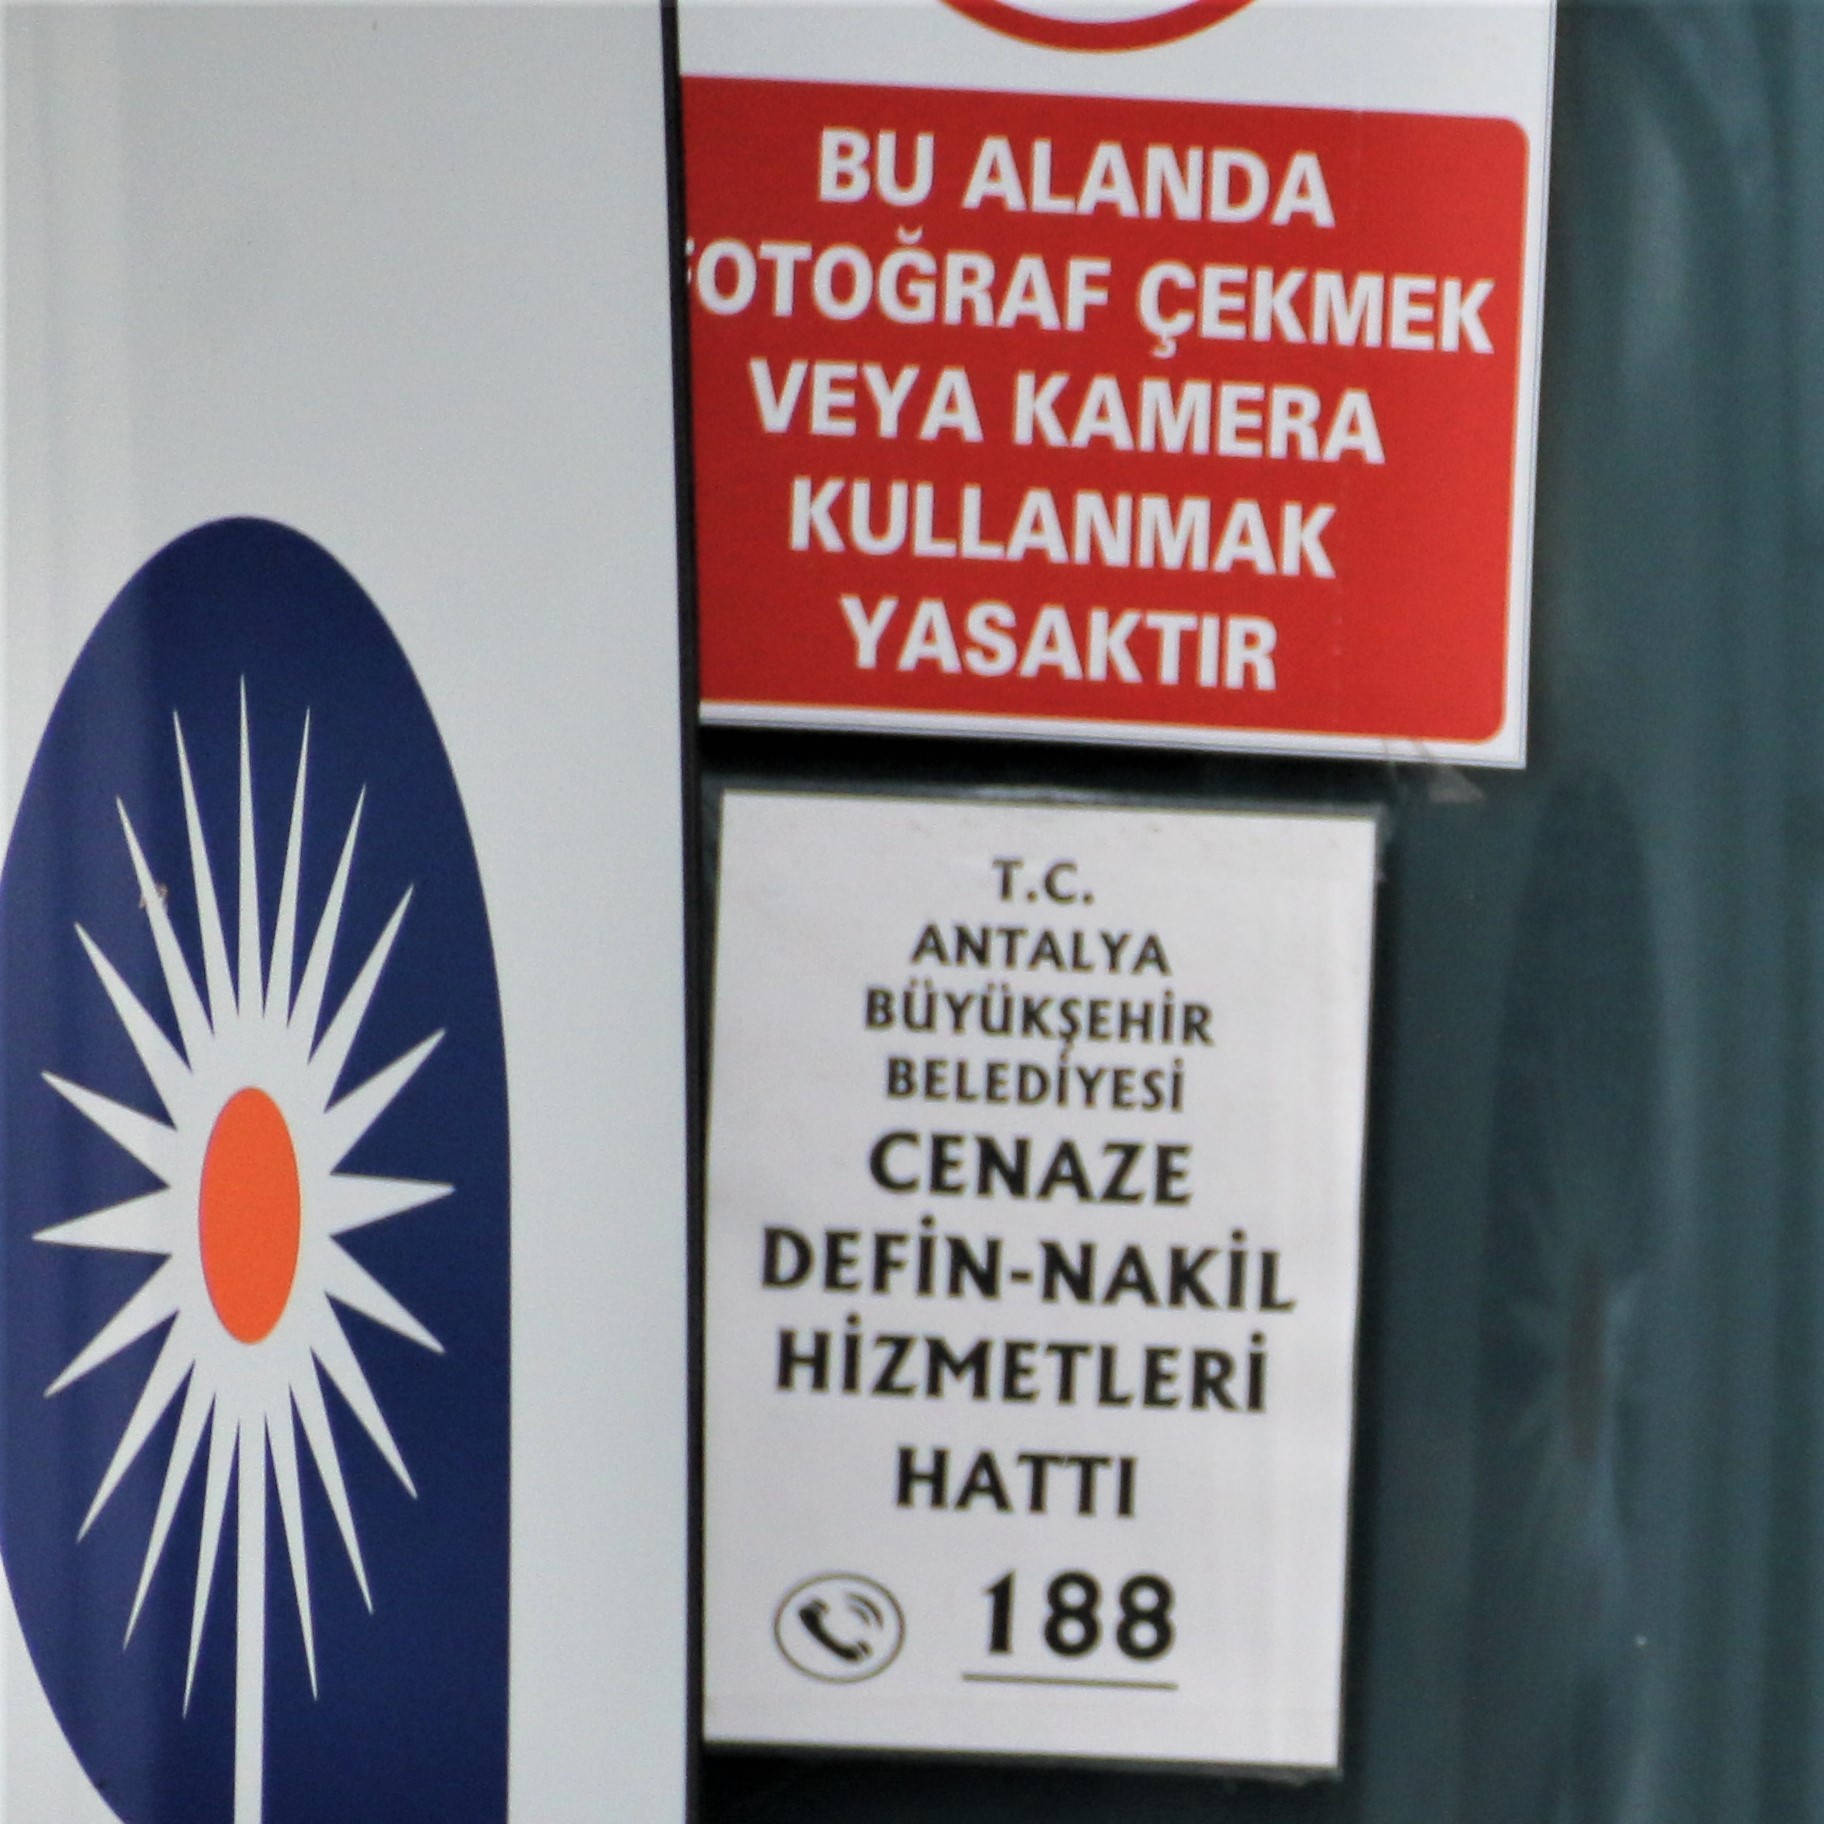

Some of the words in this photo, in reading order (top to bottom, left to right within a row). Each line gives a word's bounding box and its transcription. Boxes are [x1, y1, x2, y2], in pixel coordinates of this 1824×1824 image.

[818, 127, 935, 207] BU
[962, 136, 1336, 229] ALANDA
[686, 226, 1112, 333] OTOĞRAF
[1137, 260, 1496, 359] ÇEKMEK
[748, 358, 984, 443] VEYA
[1013, 371, 1386, 466] KAMERA
[790, 476, 1336, 579] KULLANMAK
[839, 595, 1278, 692] YASAKTIR
[993, 858, 1095, 906] T.C.
[909, 923, 1172, 976] ANTALYA
[863, 978, 1215, 1050] BÜYÜKŞEHİR
[885, 1052, 1185, 1113] BELEDİYESİ
[867, 1129, 1192, 1207] CENAZE
[760, 1214, 1297, 1313] DEFİN-NAKİL
[774, 1312, 1268, 1413] HİZMETLERİ
[895, 1445, 1138, 1519] HATTI
[982, 1569, 1177, 1663] 188
